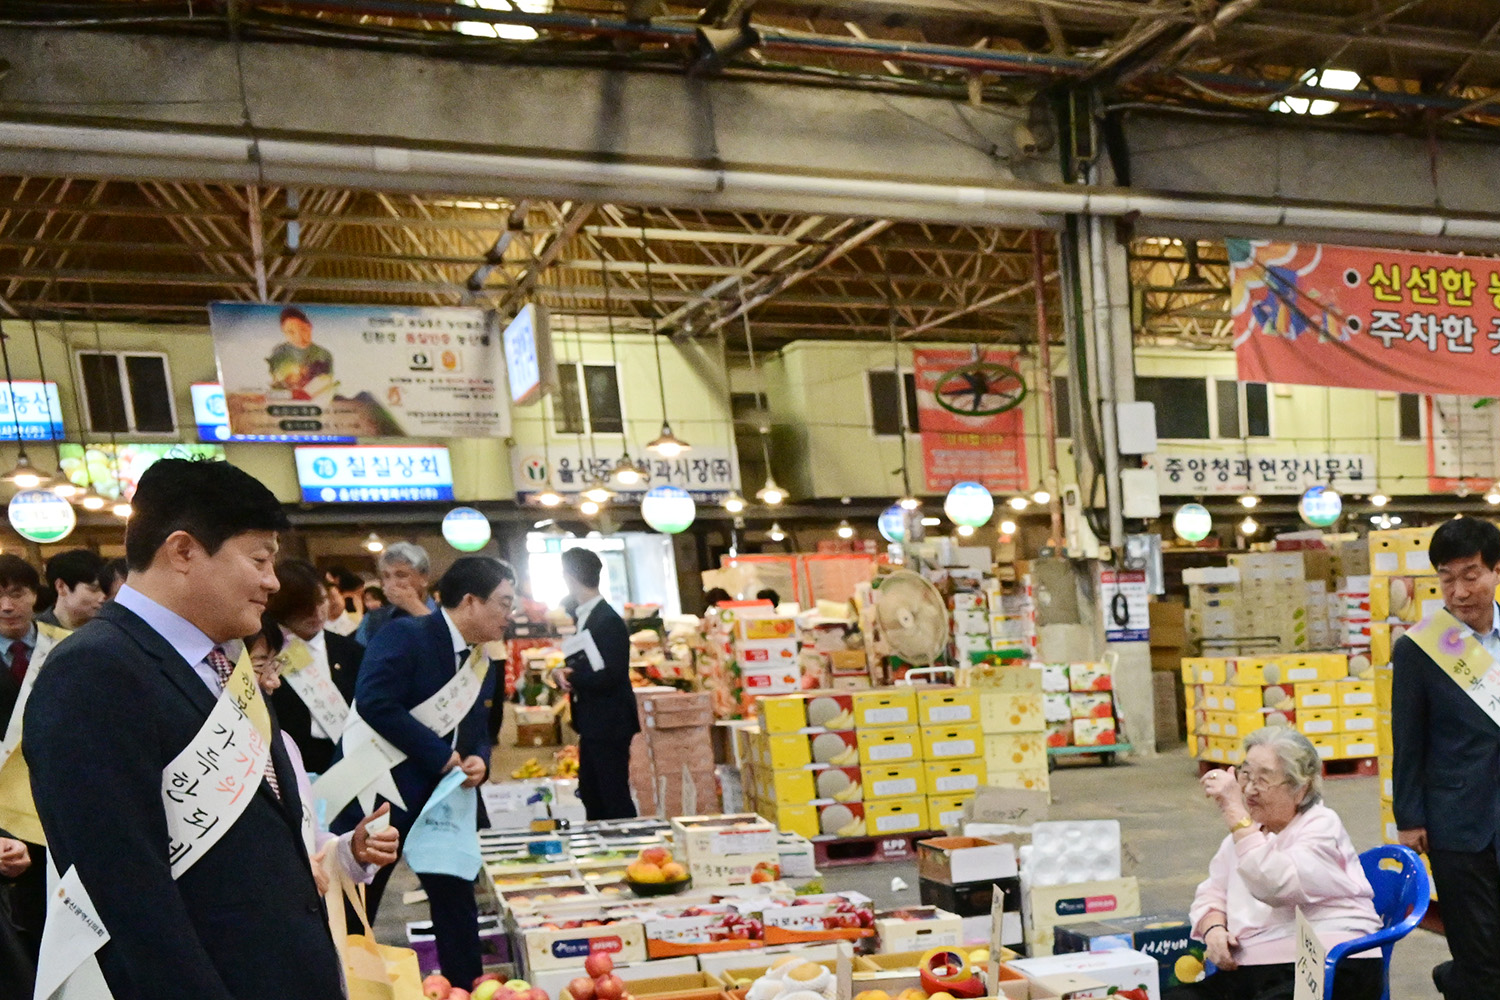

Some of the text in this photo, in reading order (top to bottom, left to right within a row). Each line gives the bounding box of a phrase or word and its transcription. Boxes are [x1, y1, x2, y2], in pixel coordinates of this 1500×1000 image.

[1368, 262, 1477, 307] 신선한
[1369, 309, 1478, 353] 주차한
[347, 456, 440, 478] 칠칠상회
[168, 723, 238, 804] 가득한
[215, 729, 265, 805] 한가위
[62, 895, 106, 940] 울산광역시의회
[1140, 937, 1189, 957] 서생배
